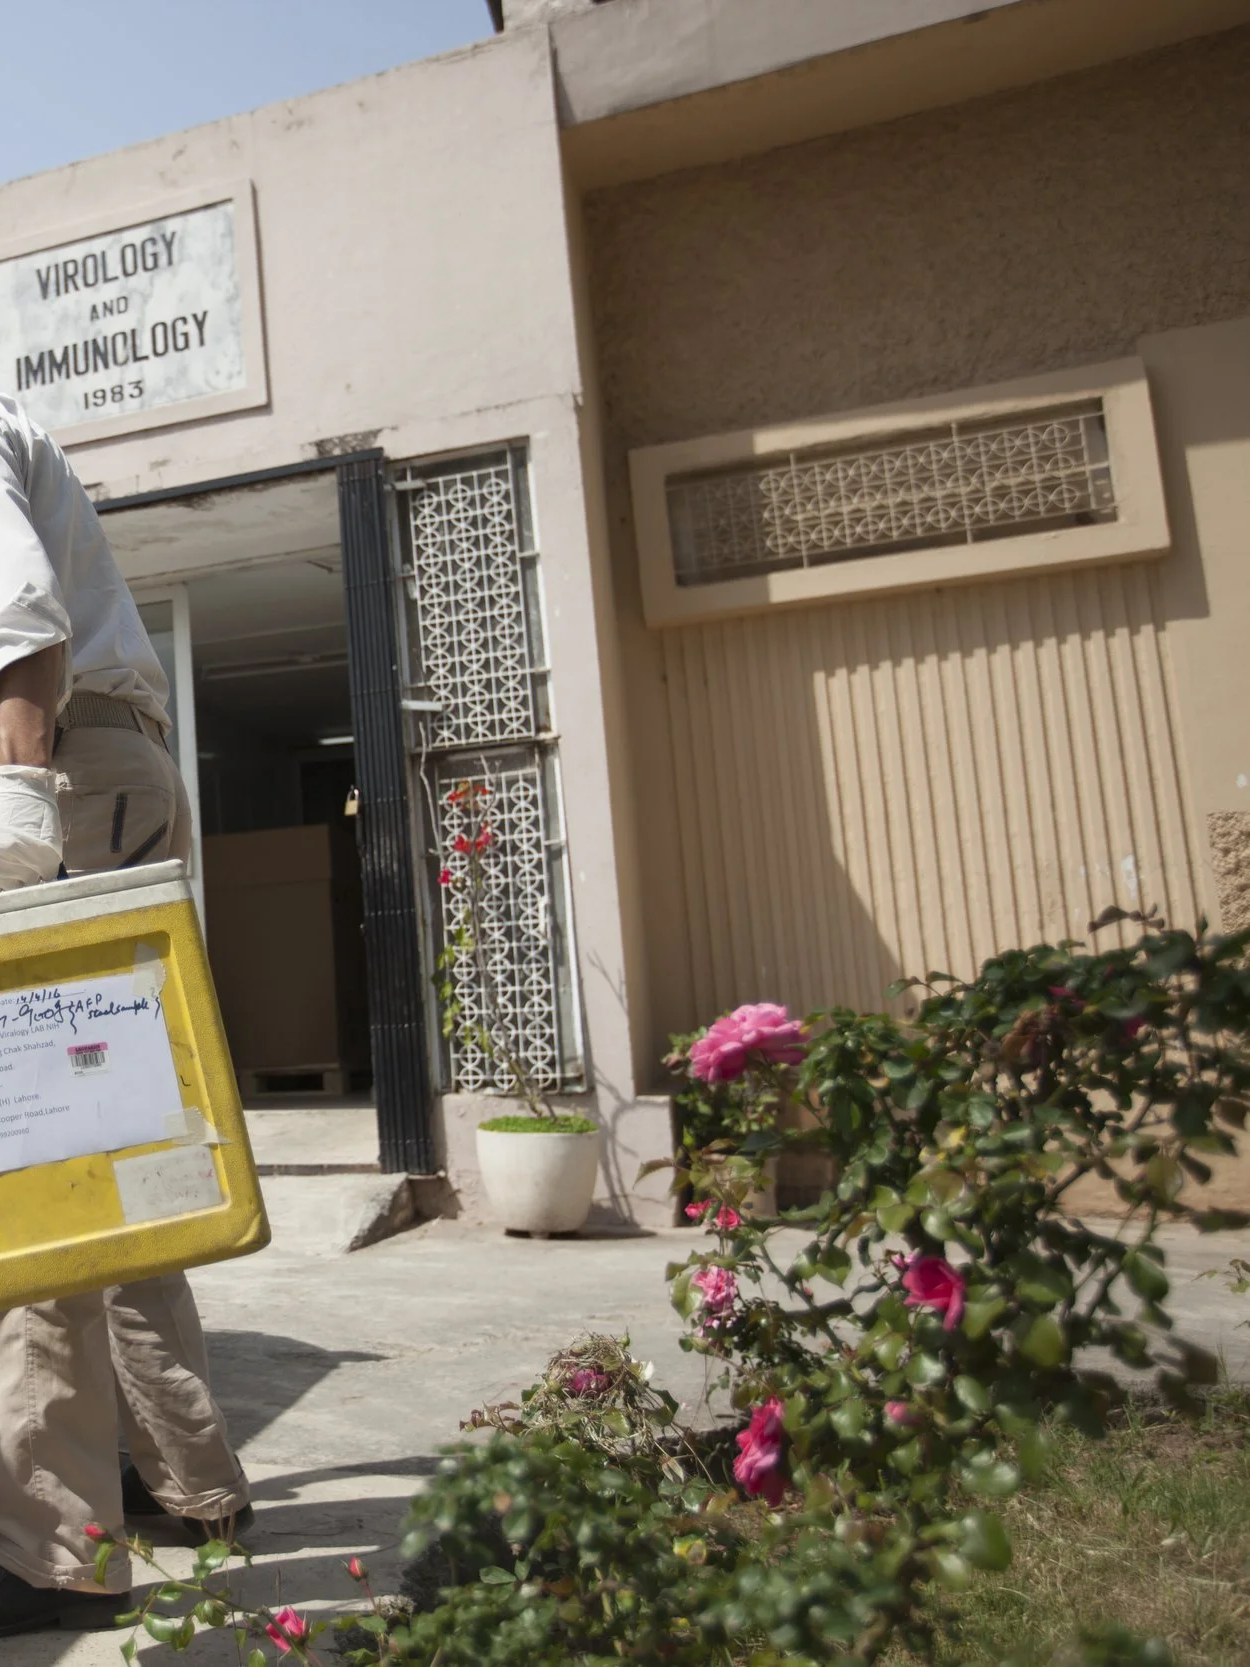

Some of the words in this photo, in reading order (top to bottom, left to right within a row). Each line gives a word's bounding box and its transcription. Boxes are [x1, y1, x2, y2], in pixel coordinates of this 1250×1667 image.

[36, 231, 177, 300] VIROLOGY
[89, 295, 129, 322] AND
[16, 310, 208, 391] IMMUNOLOGY
[83, 380, 144, 409] 1983
[30, 1025, 45, 1035] LAB
[46, 1022, 61, 1032] NIH
[3, 1045, 22, 1055] Chak
[0, 1098, 11, 1109] (H)
